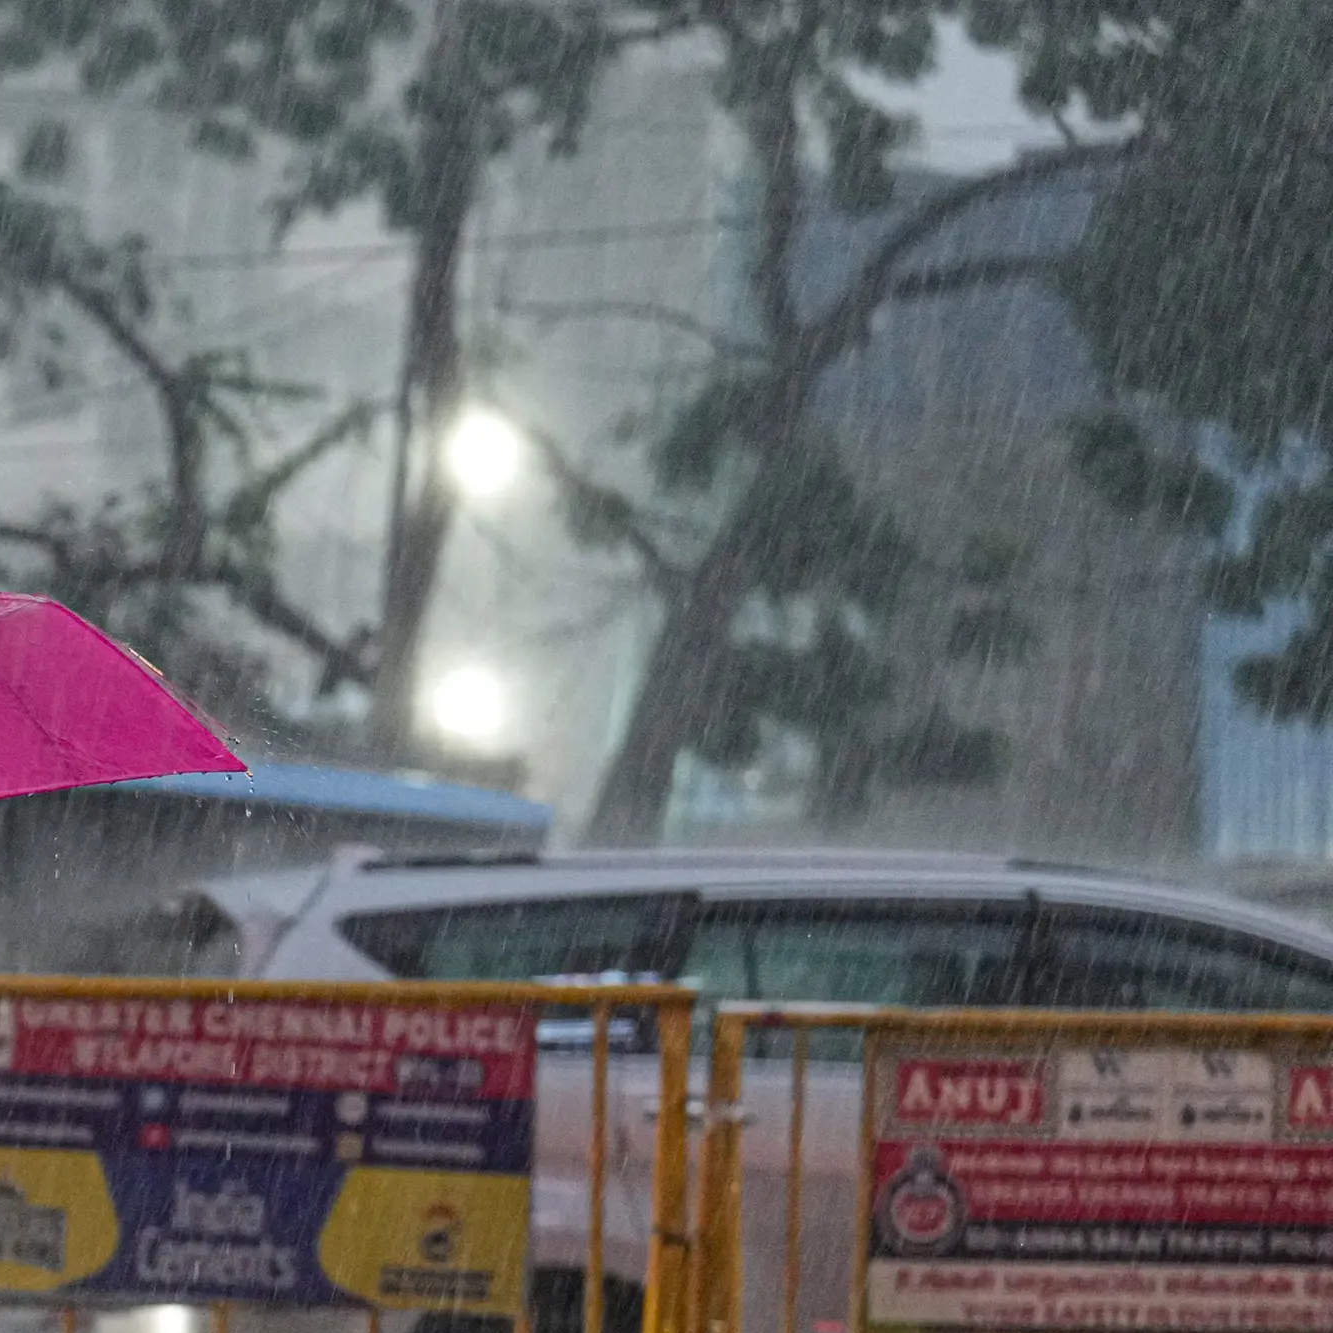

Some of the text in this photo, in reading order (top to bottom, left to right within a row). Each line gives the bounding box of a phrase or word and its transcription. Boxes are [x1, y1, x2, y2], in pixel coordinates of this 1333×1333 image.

[204, 1003, 373, 1044] CHENNAI
[383, 1009, 515, 1052] POLICE
[902, 1069, 1035, 1123] ANUJ
[1296, 1075, 1325, 1115] A
[172, 1178, 264, 1234] India
